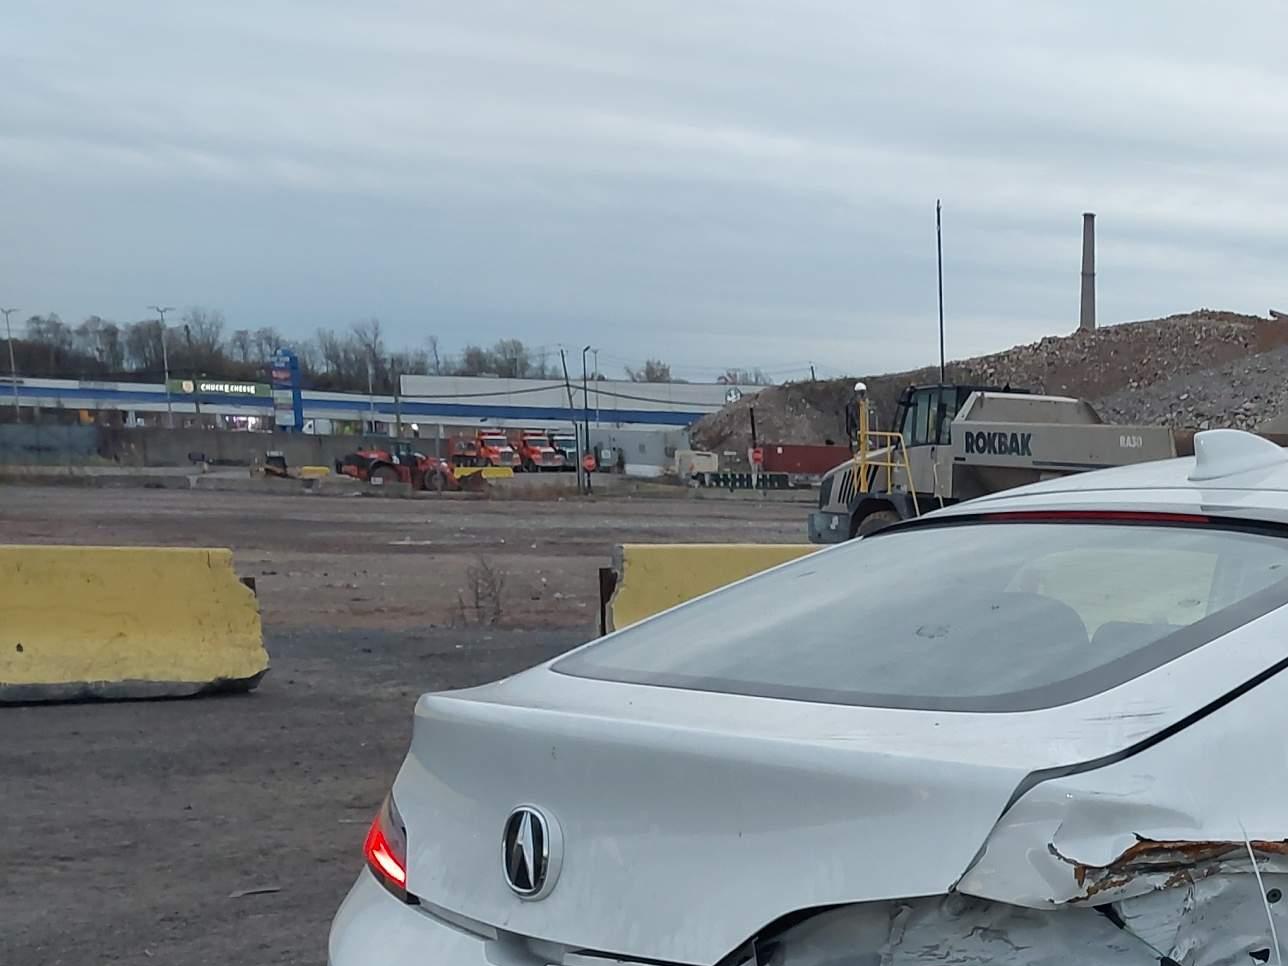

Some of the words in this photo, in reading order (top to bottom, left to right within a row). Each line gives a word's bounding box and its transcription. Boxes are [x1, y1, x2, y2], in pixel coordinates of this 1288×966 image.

[200, 383, 224, 391] CHUCK
[230, 385, 256, 394] CHEESE
[965, 431, 1032, 456] ROKBAK
[1119, 435, 1143, 449] RA30
